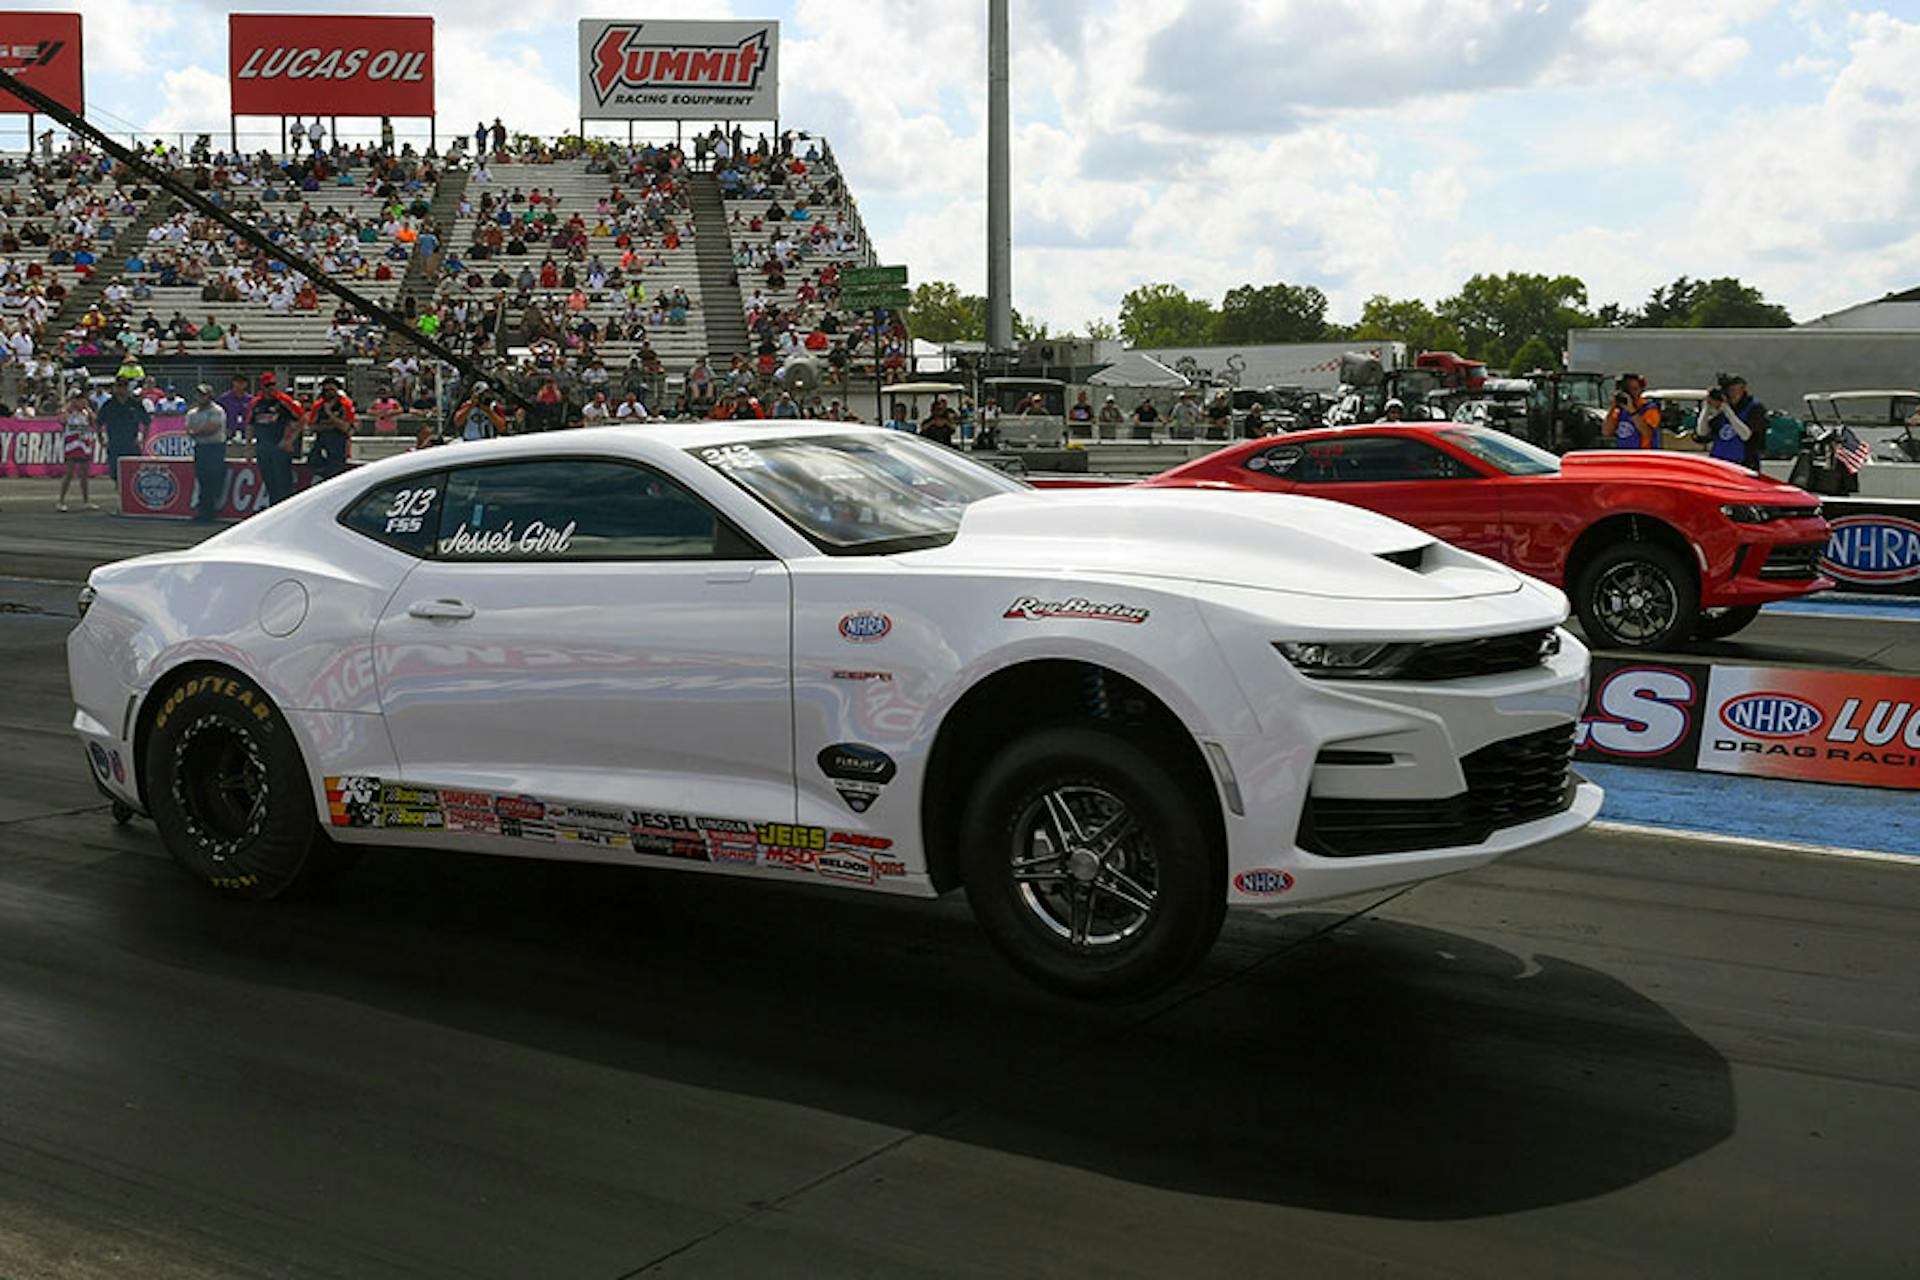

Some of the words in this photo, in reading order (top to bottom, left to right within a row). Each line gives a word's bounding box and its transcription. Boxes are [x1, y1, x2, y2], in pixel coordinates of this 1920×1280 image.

[238, 48, 368, 79] LUCAS
[367, 50, 426, 80] OIL
[614, 94, 668, 104] RACING
[672, 95, 754, 105] EQUIPMENT
[14, 431, 66, 465] GRAN
[385, 488, 436, 518] 313
[385, 517, 423, 533] FSS
[440, 521, 514, 554] Jesse's
[519, 521, 577, 554] Girl
[1827, 526, 1920, 569] NHRA
[846, 616, 886, 635] NHRA
[156, 675, 270, 729] GOODYEAR
[1734, 700, 1812, 732] NHRA
[1713, 739, 1817, 758] DRAG
[627, 810, 697, 832] JESEL
[759, 824, 825, 849] JEGS
[766, 848, 815, 865] MSD
[1242, 872, 1287, 891] NHRA
